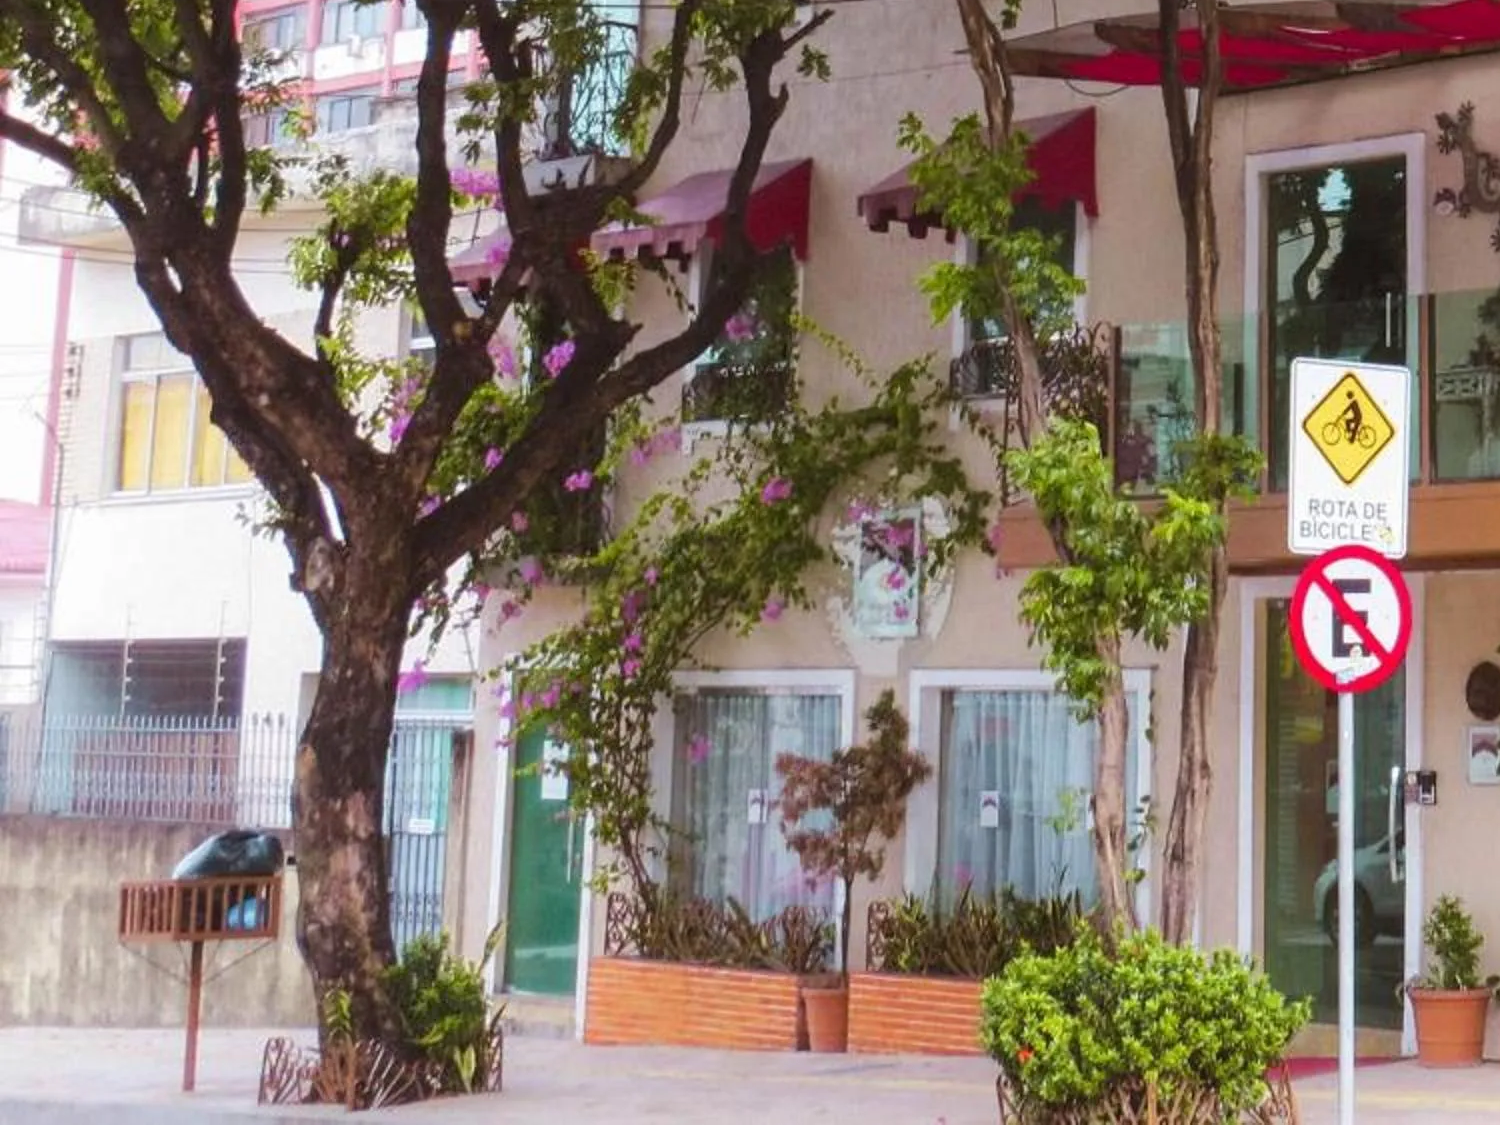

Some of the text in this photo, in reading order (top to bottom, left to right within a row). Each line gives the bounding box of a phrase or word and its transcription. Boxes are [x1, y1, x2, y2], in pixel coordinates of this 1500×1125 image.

[1308, 498, 1388, 521] ROTA DE
[1299, 519, 1393, 544] BICICLE
[1332, 579, 1371, 657] E
